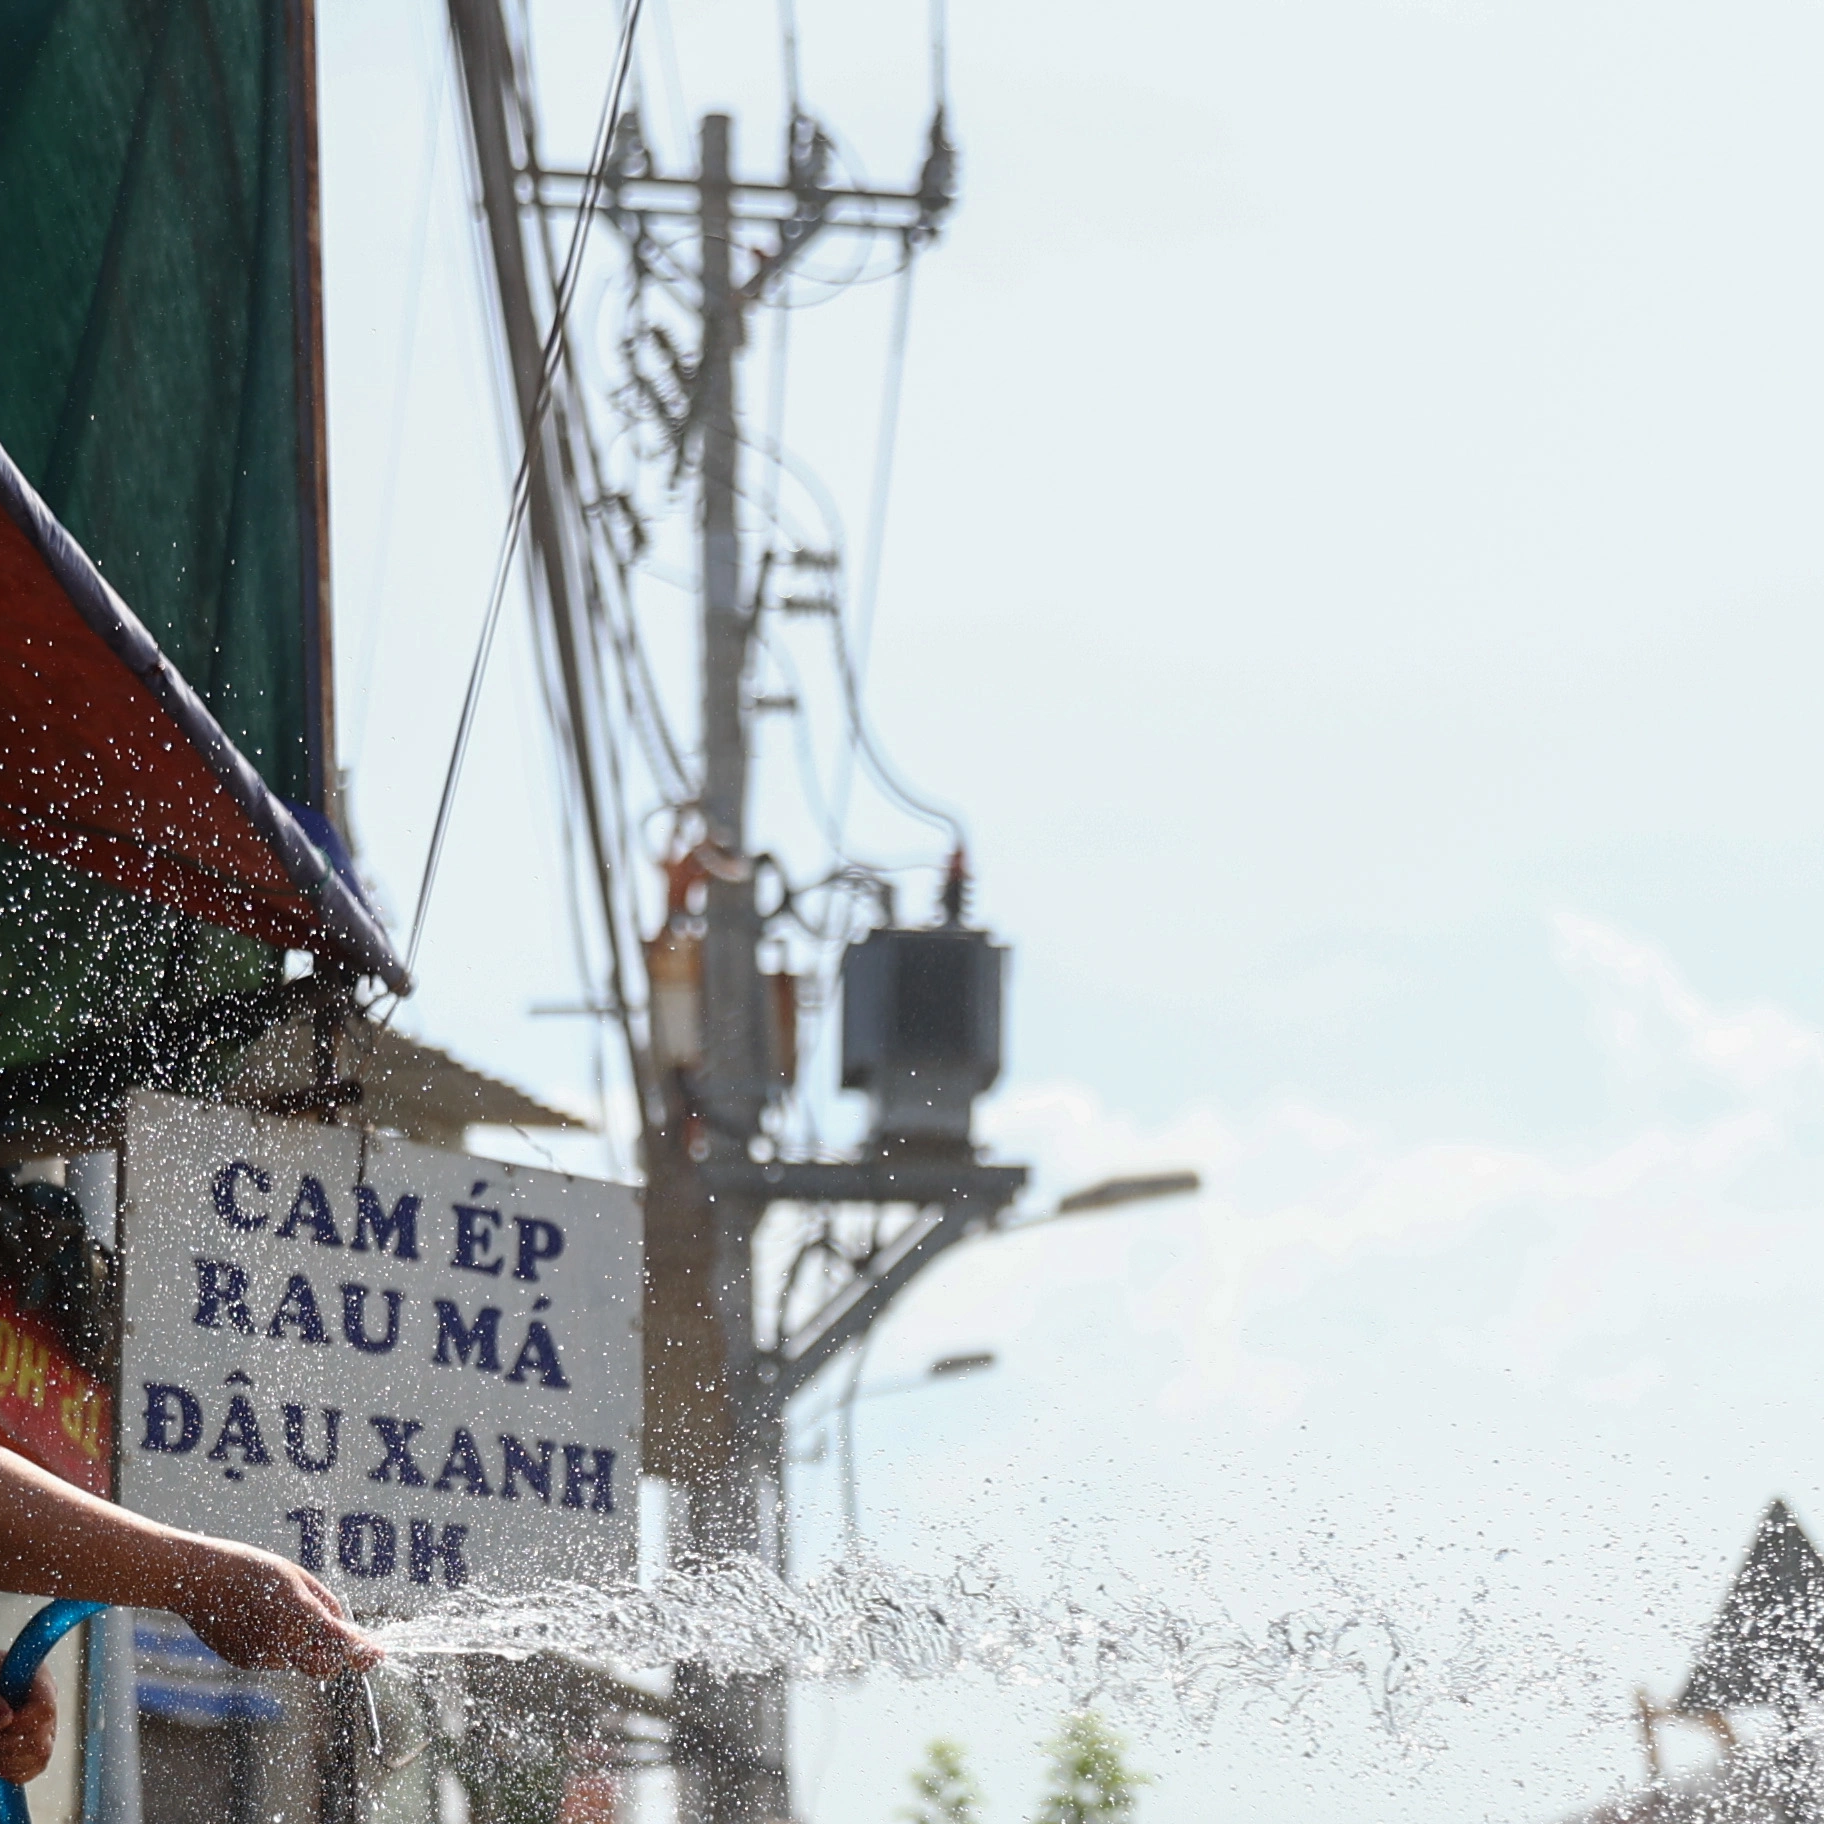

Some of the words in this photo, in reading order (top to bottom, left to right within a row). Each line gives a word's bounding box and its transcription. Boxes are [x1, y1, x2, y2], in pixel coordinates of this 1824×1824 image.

[210, 1160, 422, 1262] CAM
[448, 1180, 567, 1284] ÉP
[192, 1256, 406, 1356] RAU
[431, 1294, 573, 1391] MÁ
[138, 1370, 343, 1482] ĐẬU
[366, 1412, 618, 1516] XANH
[284, 1506, 471, 1589] 10K
